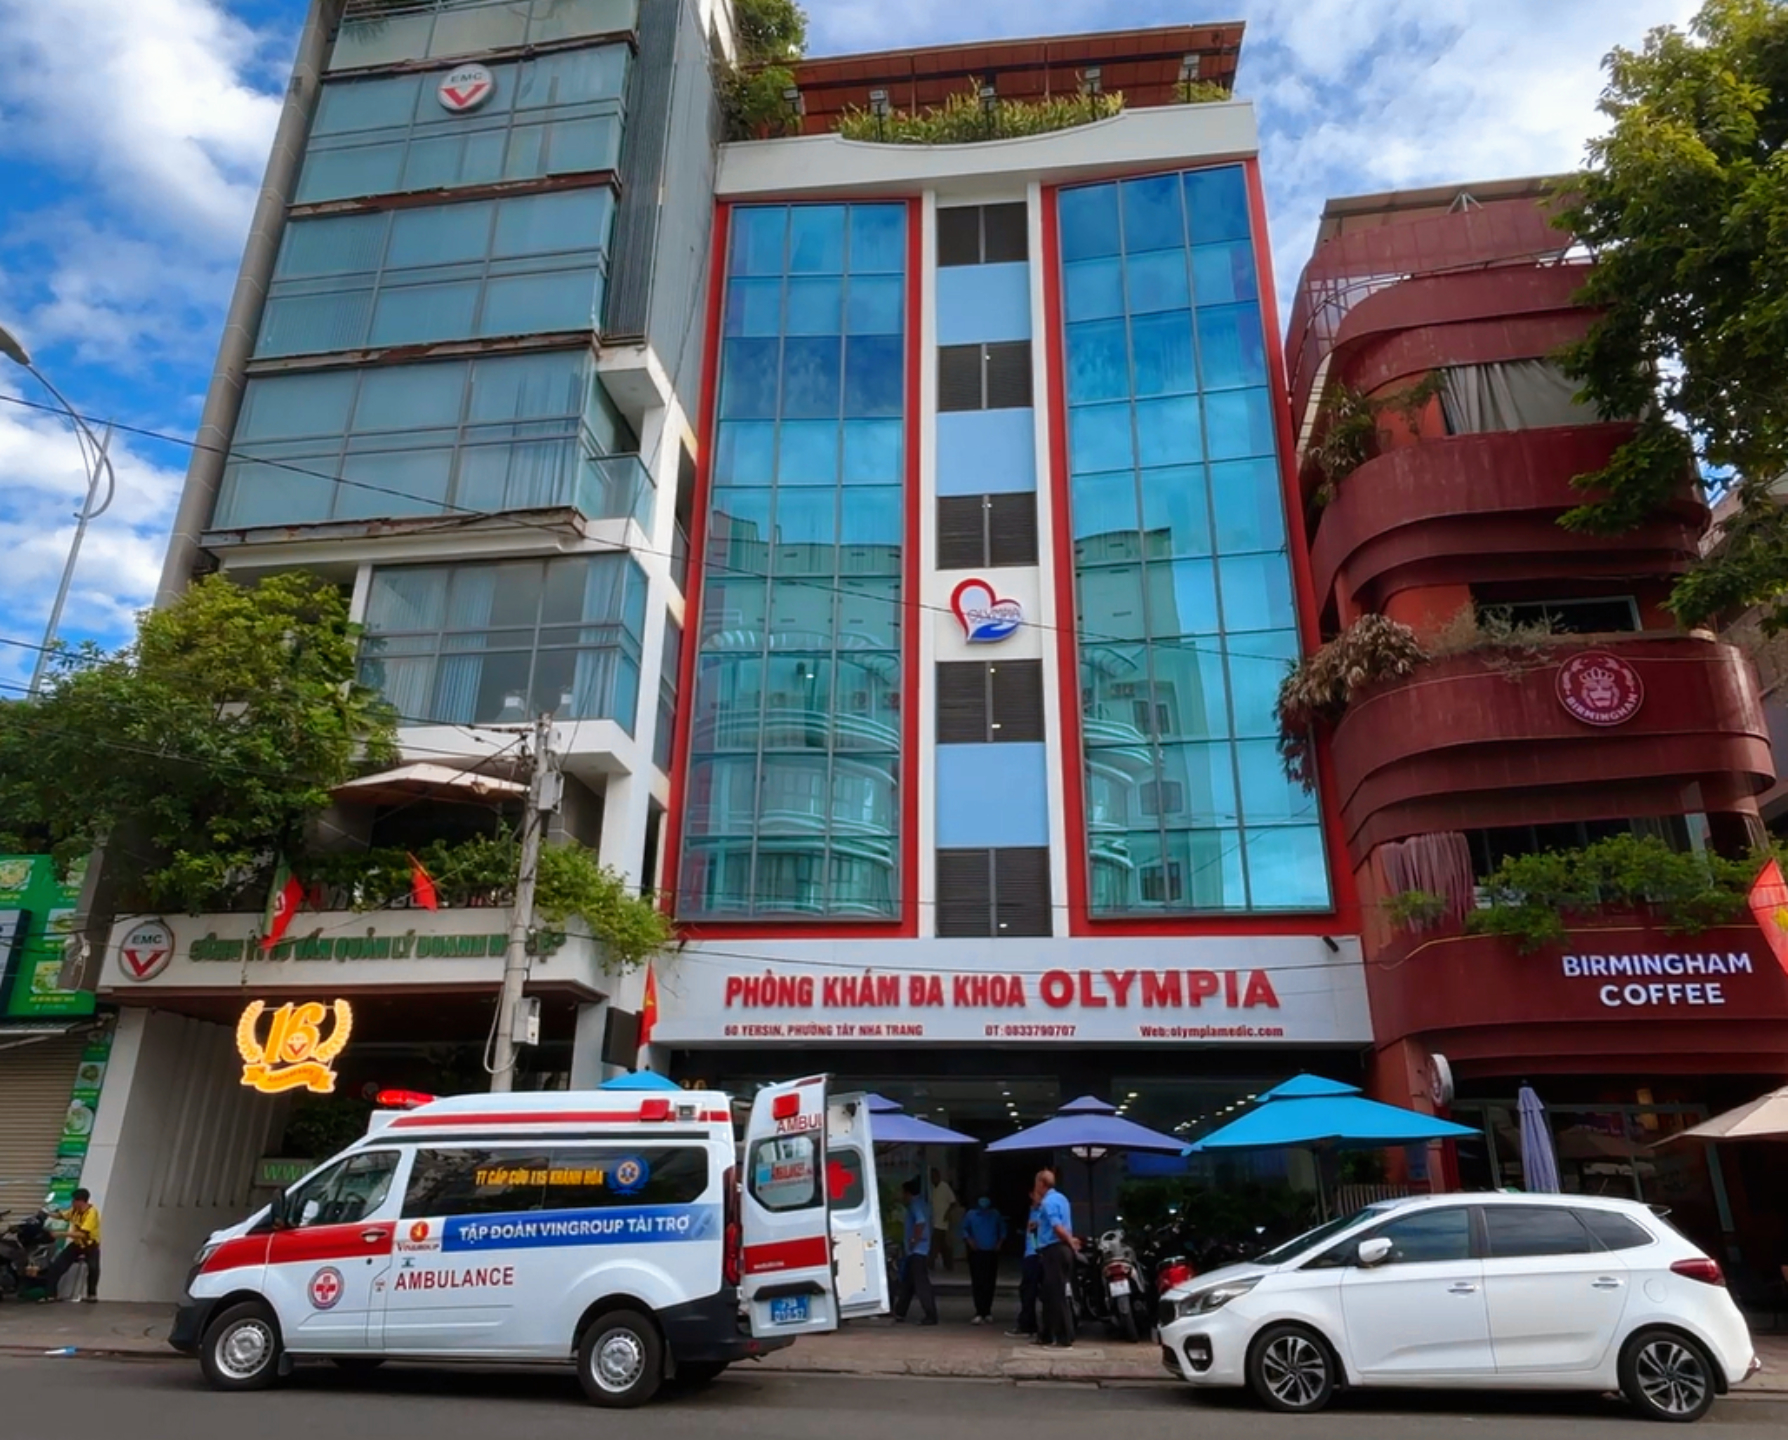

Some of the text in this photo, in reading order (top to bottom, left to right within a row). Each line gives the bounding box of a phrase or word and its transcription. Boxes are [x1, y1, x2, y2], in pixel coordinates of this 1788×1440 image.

[132, 934, 162, 945] EMC
[1562, 952, 1752, 977] BIRMINGHAM
[725, 967, 1280, 1008] PHÒNG KHÁM ĐA KHOA OLYMPIA
[1600, 983, 1725, 1006] COFFEE
[265, 1001, 326, 1063] 16
[742, 1024, 785, 1037] YERSIN,
[859, 1024, 882, 1036] NHA
[885, 1024, 923, 1036] TRANG
[459, 1214, 691, 1244] TẬP ĐOÀN VINGROUP TÀI TRỢ
[394, 1266, 514, 1291] AMBULANCE
